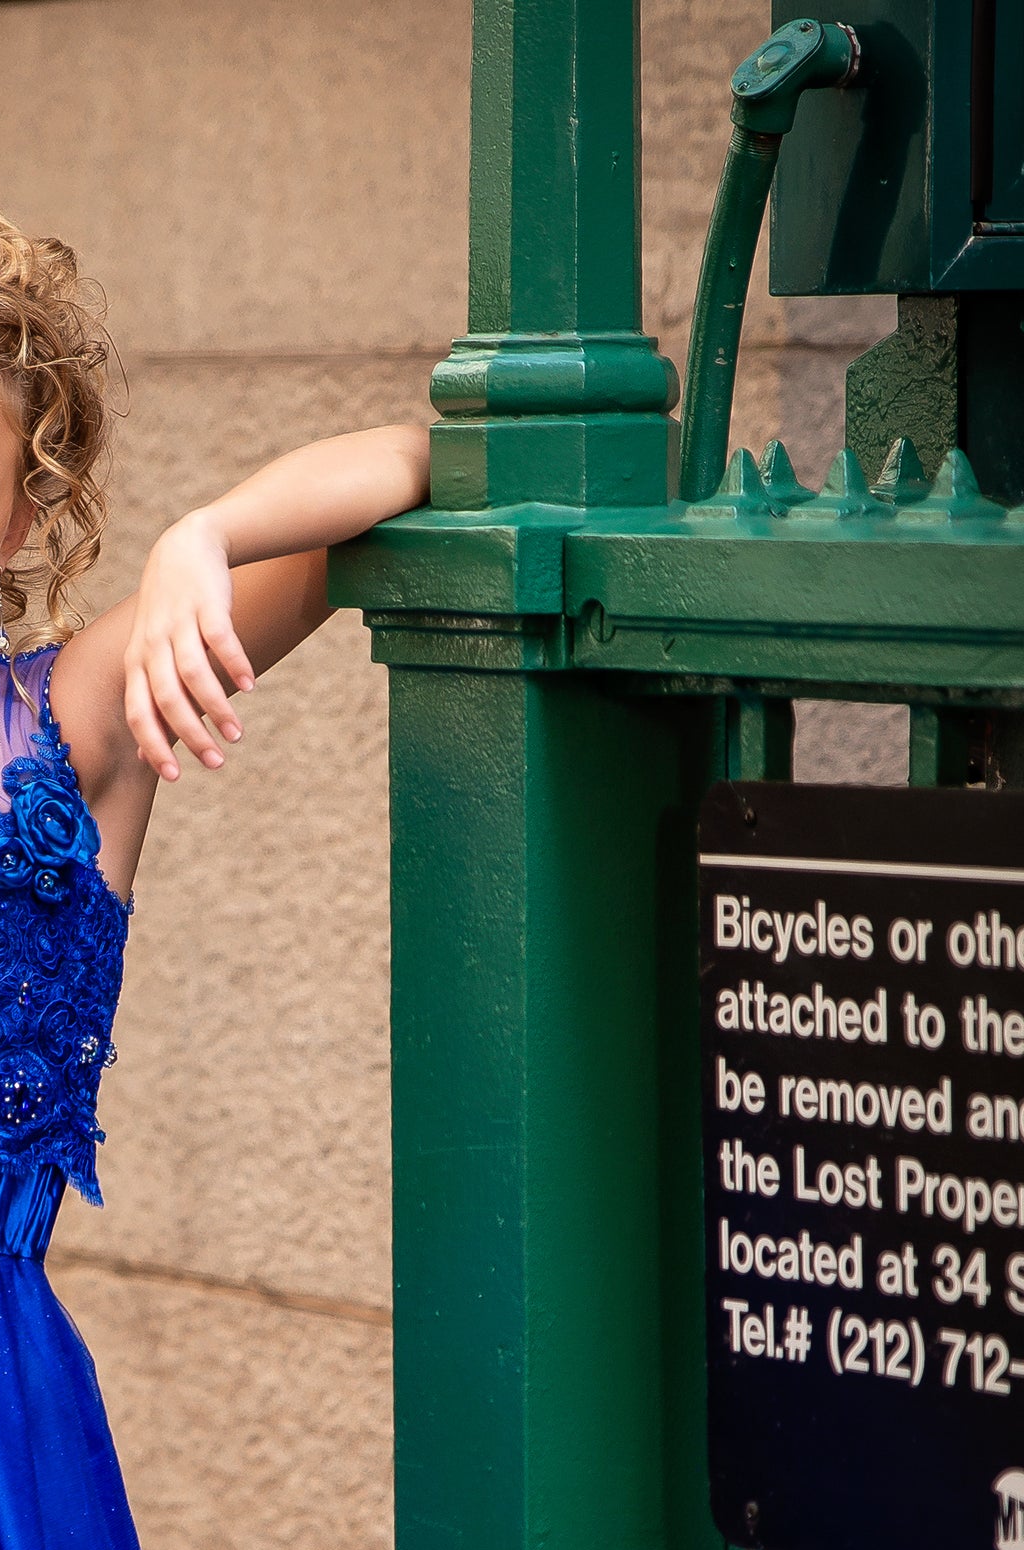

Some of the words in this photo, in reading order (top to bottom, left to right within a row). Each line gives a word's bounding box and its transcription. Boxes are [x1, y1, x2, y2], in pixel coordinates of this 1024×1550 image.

[715, 893, 875, 964] Bicycles
[889, 917, 934, 963] or
[716, 978, 889, 1044] attached
[902, 991, 947, 1050] to
[717, 1055, 767, 1115] be
[779, 1075, 954, 1134] removed
[967, 1093, 1024, 1141] an
[718, 1139, 782, 1198] the
[794, 1144, 884, 1210] Lost
[719, 1216, 865, 1290] located
[877, 1243, 920, 1298] at
[933, 1244, 993, 1307] 34
[721, 1297, 814, 1364] Tel.#
[828, 1307, 927, 1387] (212)
